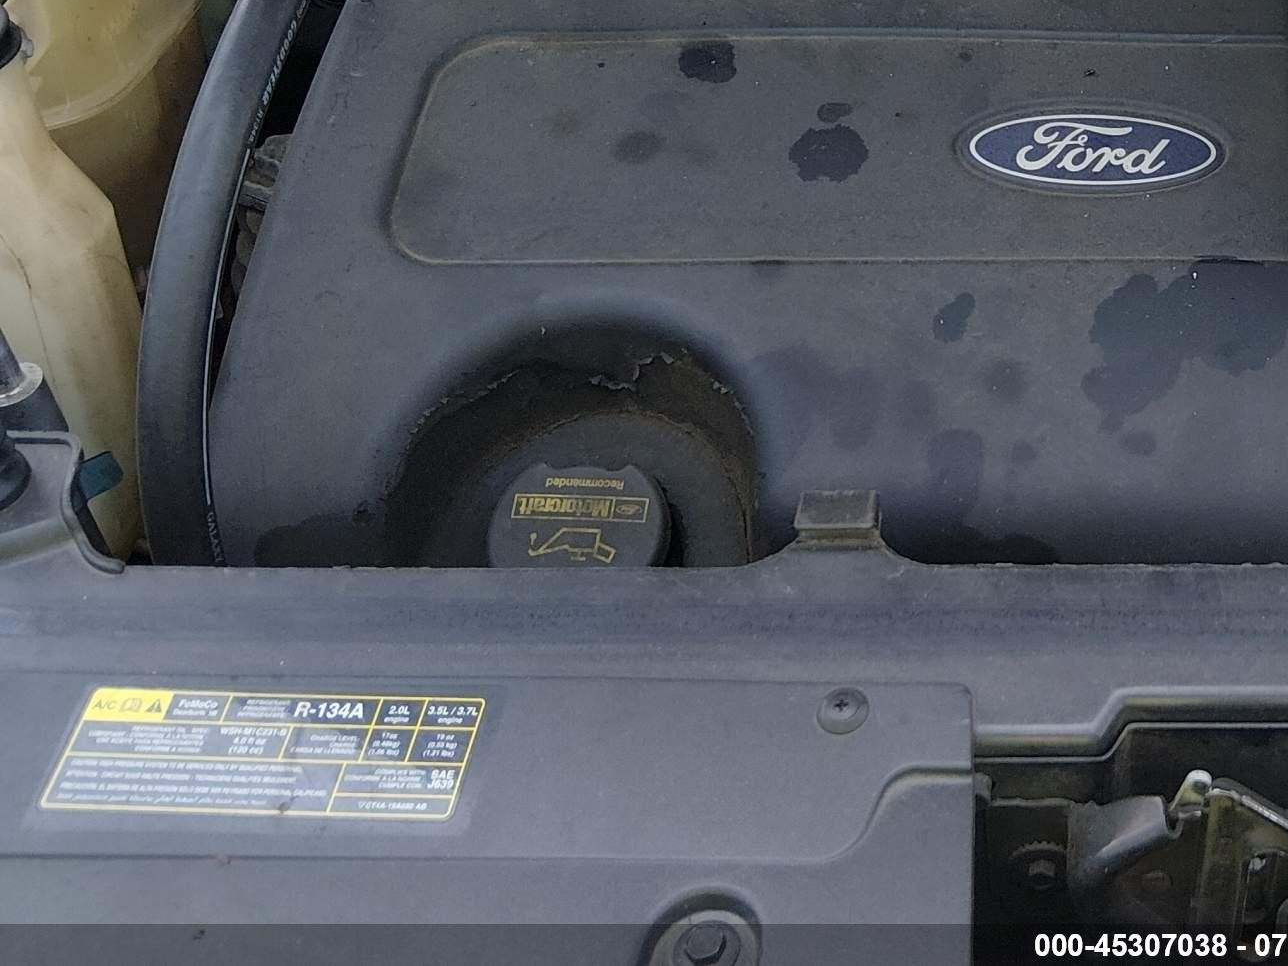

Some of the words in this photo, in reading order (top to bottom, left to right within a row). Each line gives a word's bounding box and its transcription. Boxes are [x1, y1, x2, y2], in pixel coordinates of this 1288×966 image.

[1016, 121, 1171, 174] Ford
[544, 476, 625, 490] Recommended
[519, 496, 611, 518] Motorcraft
[92, 699, 117, 711] A/C
[293, 701, 365, 719] R-134A
[388, 705, 411, 715] 2.0L
[427, 706, 450, 715] 3.5L
[456, 707, 479, 716] 3.7L
[383, 716, 410, 724] engine
[437, 717, 464, 725] engine
[431, 769, 455, 779] SAE
